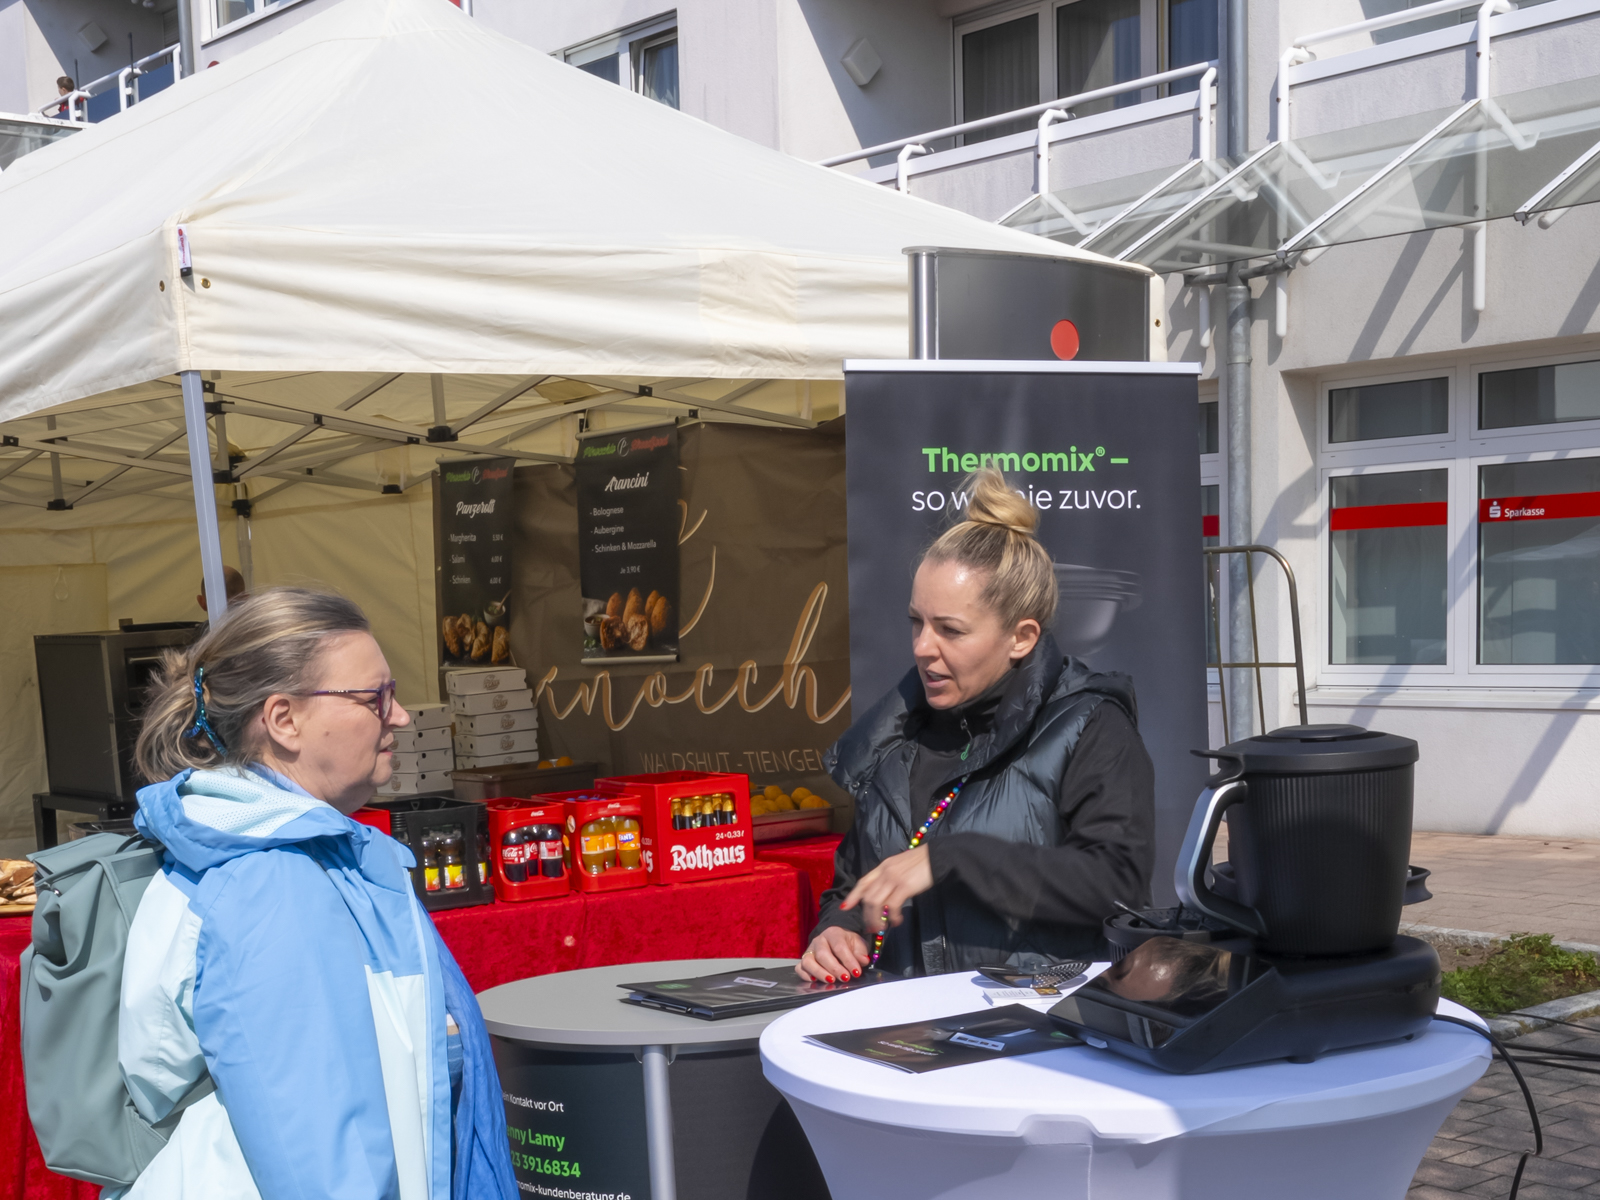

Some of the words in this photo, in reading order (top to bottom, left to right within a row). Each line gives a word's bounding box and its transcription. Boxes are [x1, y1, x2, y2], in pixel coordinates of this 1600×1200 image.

[604, 472, 650, 492] Arancini
[911, 490, 946, 512] so
[1058, 489, 1142, 510] zuvor.
[593, 507, 624, 517] Bolognese
[1504, 507, 1545, 519] Sparkasse
[594, 525, 624, 535] Aubergine
[595, 543, 620, 553] Schinken
[621, 542, 627, 551] &
[627, 539, 657, 550] Mozzarella
[640, 752, 729, 774] WALDSHUT
[670, 844, 745, 871] Rothaus
[510, 1093, 533, 1109] Kontakt
[533, 1101, 547, 1110] vor
[548, 1101, 564, 1112] Ort
[528, 1129, 565, 1152] Lamy
[522, 1154, 581, 1178] 3916834
